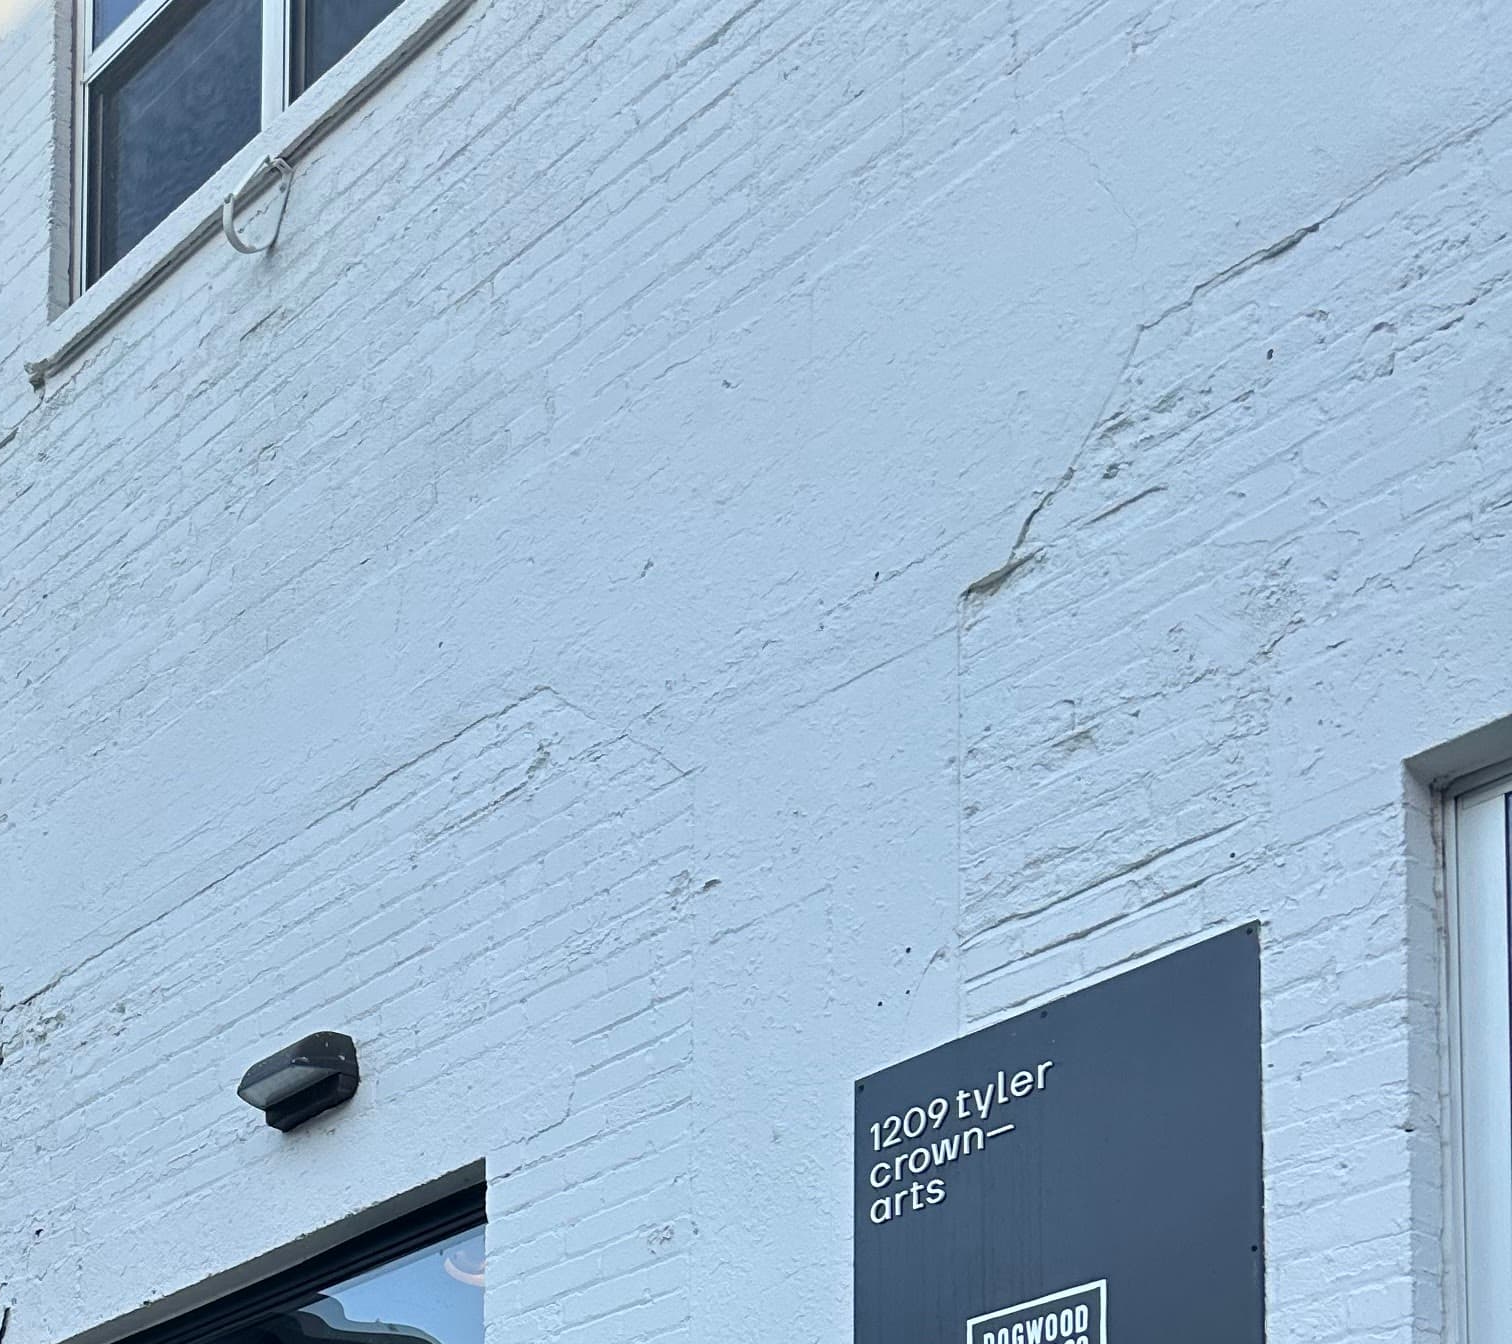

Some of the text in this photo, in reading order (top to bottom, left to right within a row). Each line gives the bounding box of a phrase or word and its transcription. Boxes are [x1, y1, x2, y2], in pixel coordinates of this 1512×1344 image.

[869, 1059, 1055, 1152] 1209 tyler
[869, 1178, 946, 1224] arts
